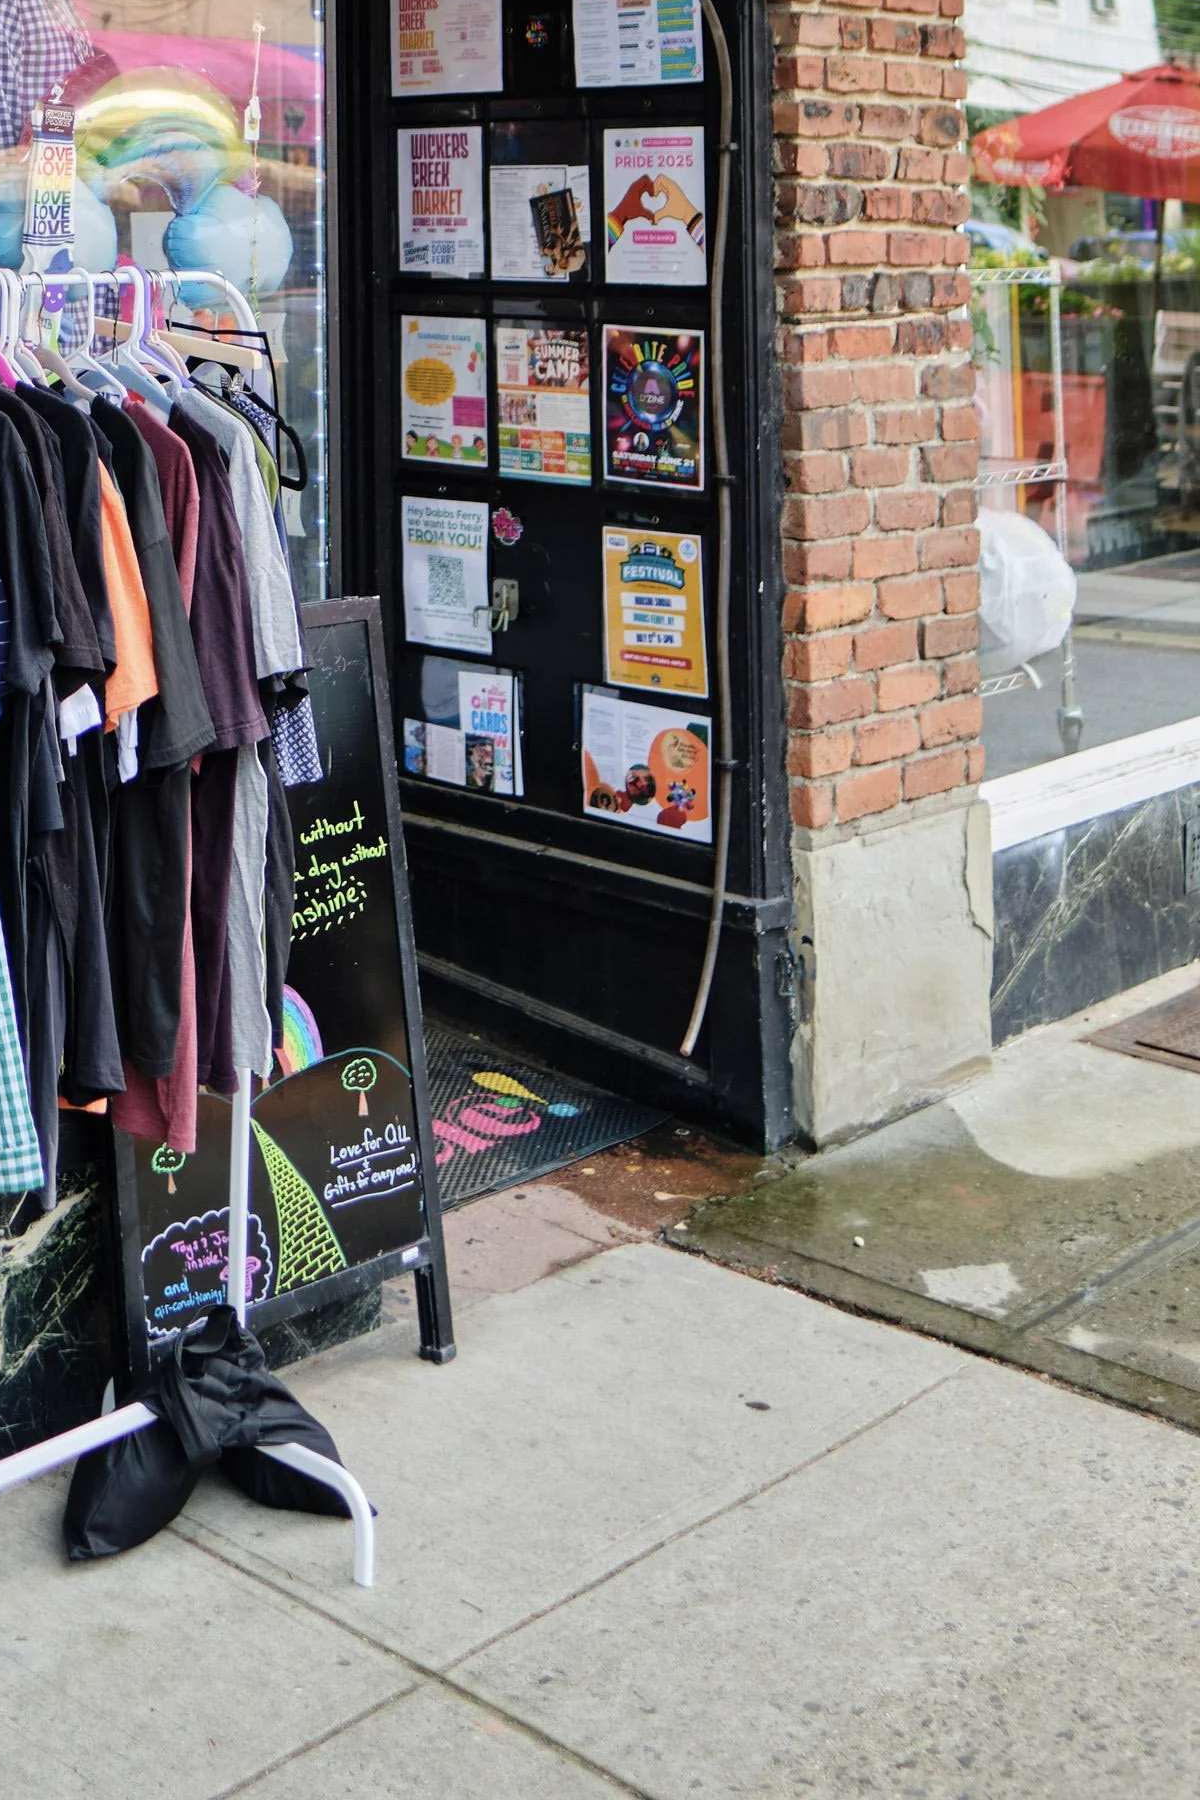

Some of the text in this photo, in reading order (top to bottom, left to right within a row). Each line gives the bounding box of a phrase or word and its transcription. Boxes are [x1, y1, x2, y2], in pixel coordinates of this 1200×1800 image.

[399, 12, 426, 31] CREEK
[399, 31, 434, 50] MARKET
[411, 133, 469, 160] WICKERS
[615, 154, 694, 169] PRIDE 2025
[411, 160, 450, 188] CREEK
[35, 190, 71, 205] LOVE
[412, 188, 463, 216] MARKET
[34, 205, 70, 220] LOVE
[33, 219, 71, 235] LOVE
[432, 244, 456, 255] DOBBS
[432, 254, 456, 265] FERRY
[535, 344, 580, 362] SUMMER
[535, 359, 580, 380] CAMP
[612, 451, 658, 463] SATURDAY
[658, 456, 683, 466] JUNE
[408, 506, 424, 518] Hey
[425, 507, 454, 520] Dobbs
[408, 518, 483, 532] we want to hear
[408, 528, 483, 549] FROM YOU!
[622, 565, 683, 586] FESTIVAL
[471, 710, 508, 734] CARDS
[300, 800, 365, 845] without
[308, 854, 341, 890] day
[341, 835, 388, 867] without
[291, 886, 360, 930] nshine
[330, 1144, 362, 1165] Love
[361, 1127, 383, 1152] for
[323, 1152, 417, 1201] Gifts for everyone!
[170, 1240, 199, 1261] Toys
[185, 1247, 224, 1272] inside!
[164, 1275, 190, 1298] and
[154, 1283, 227, 1319] air-conditioning!
